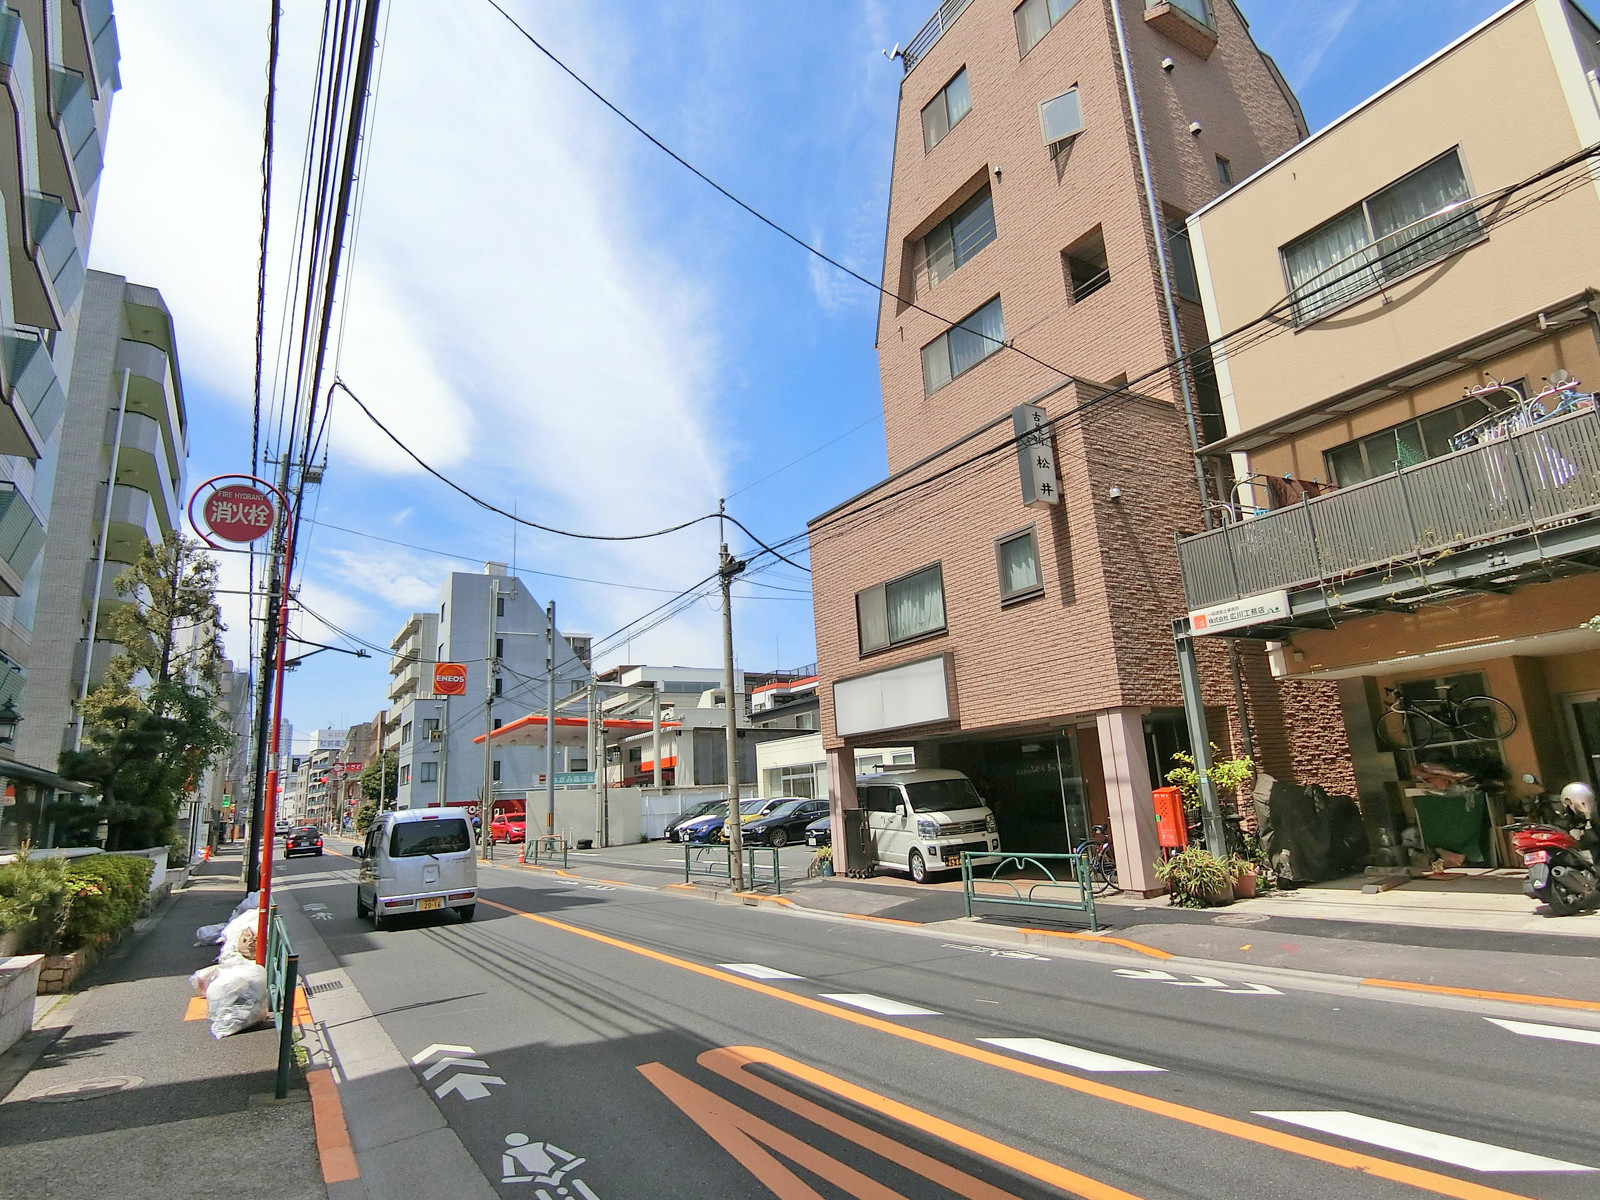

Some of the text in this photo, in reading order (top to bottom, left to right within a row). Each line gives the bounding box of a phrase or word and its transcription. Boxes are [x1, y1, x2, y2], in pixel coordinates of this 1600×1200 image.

[234, 492, 264, 500] HYDRANT
[210, 500, 270, 527] 消火栓
[1230, 606, 1264, 620] 広川工務店
[436, 674, 465, 683] ENEOS
